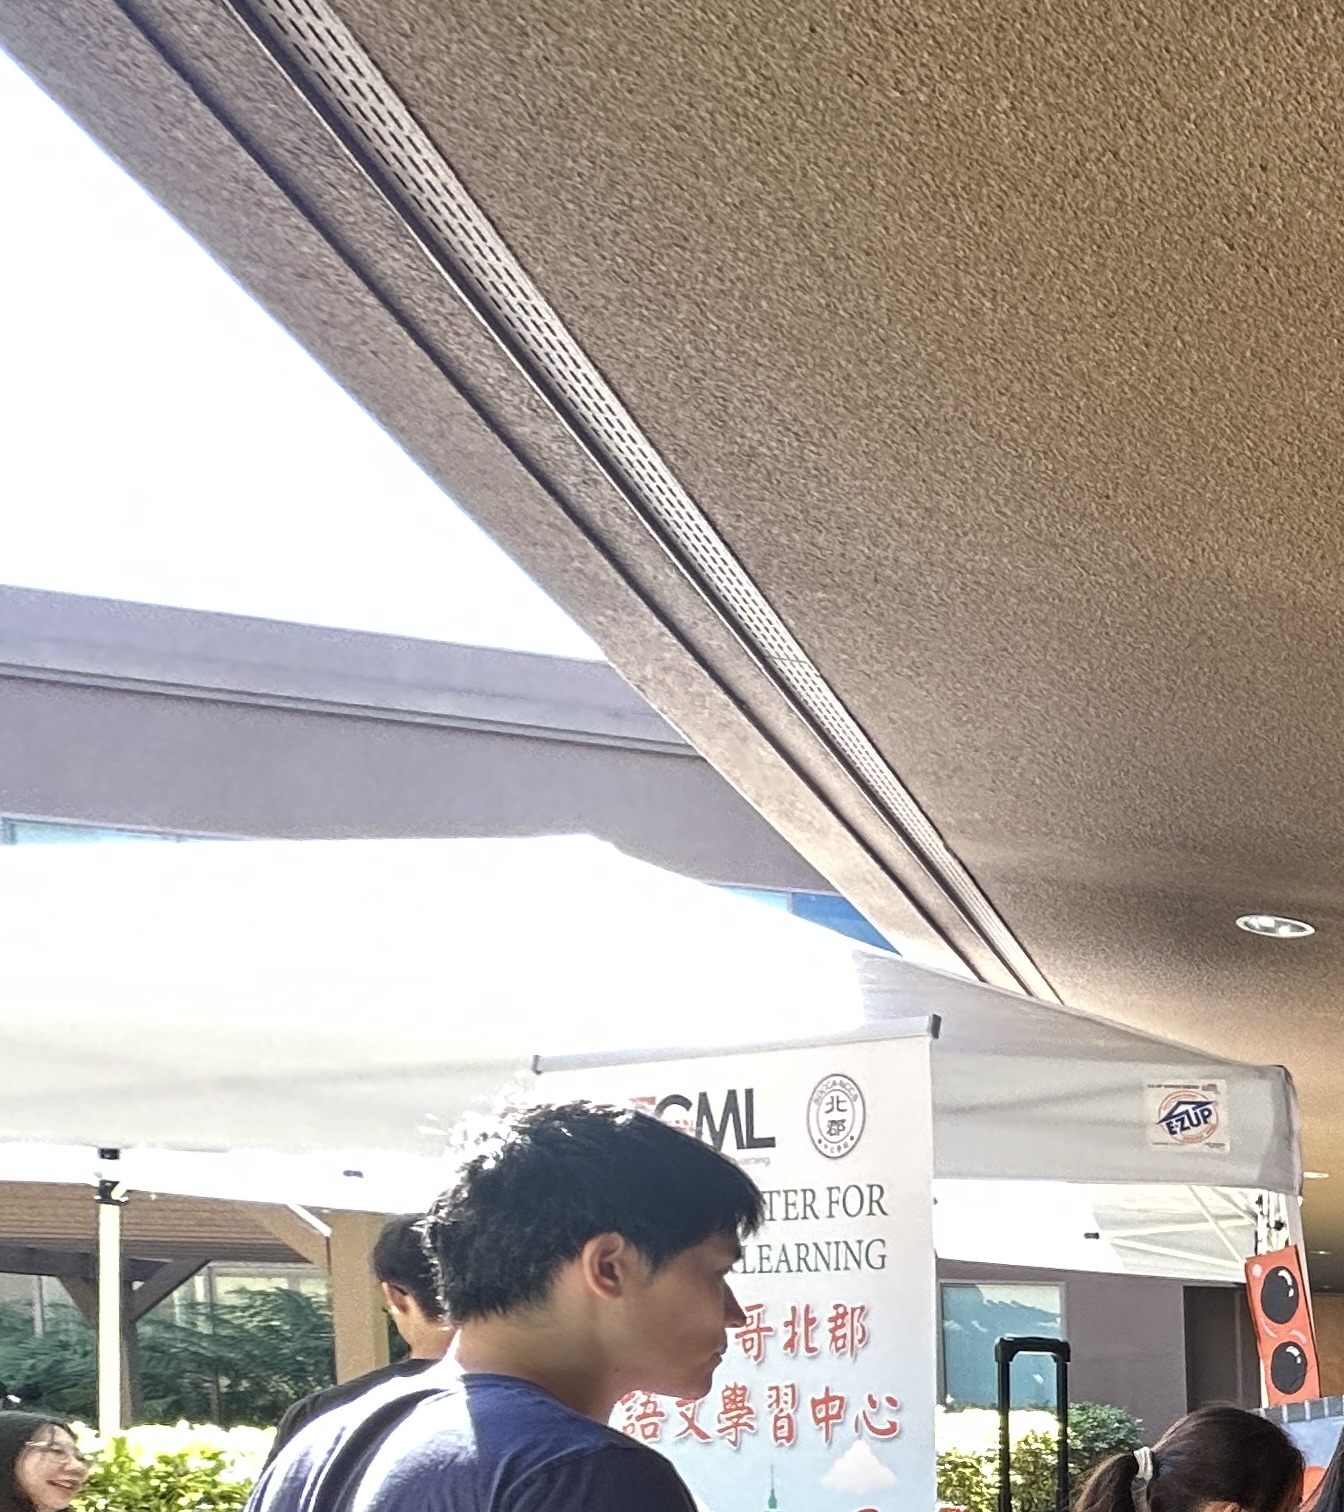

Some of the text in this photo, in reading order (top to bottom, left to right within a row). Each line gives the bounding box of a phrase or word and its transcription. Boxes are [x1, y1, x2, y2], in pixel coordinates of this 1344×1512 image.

[762, 1183, 888, 1222] TER FOR
[739, 1238, 888, 1275] LEARNING
[734, 1303, 867, 1362] 哥北郡
